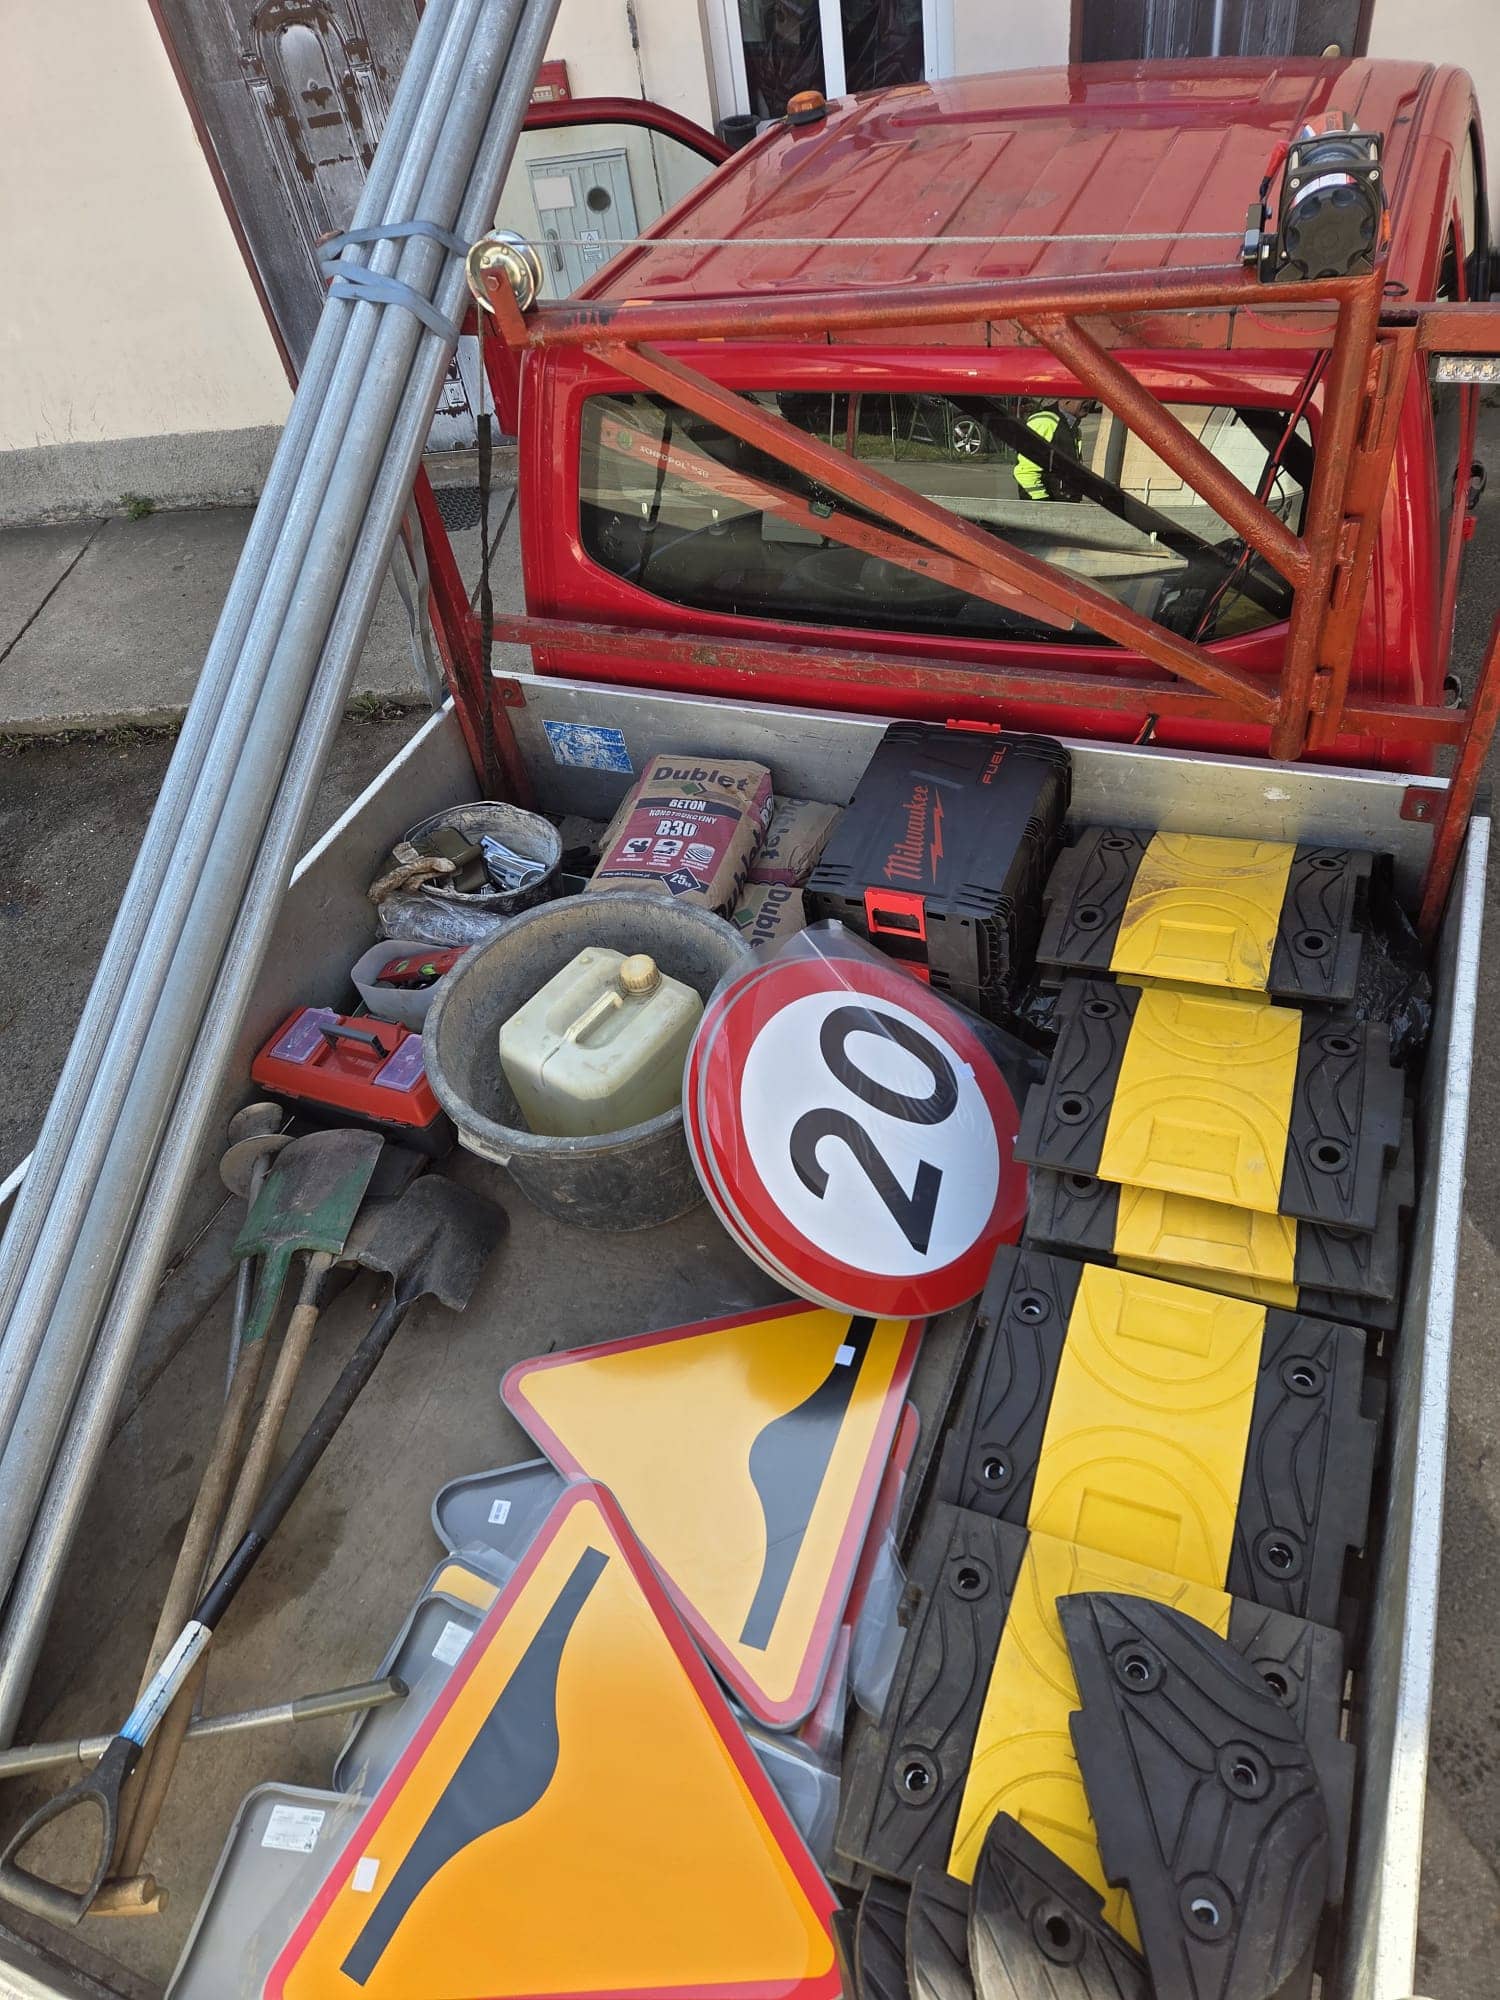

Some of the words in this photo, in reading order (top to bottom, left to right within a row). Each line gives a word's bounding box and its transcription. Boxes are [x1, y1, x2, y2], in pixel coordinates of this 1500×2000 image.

[652, 766, 749, 792] Dublet
[982, 746, 1007, 785] FUEL
[648, 809, 718, 825] KONSTRUKCYJNY
[669, 799, 707, 812] BETON
[655, 819, 698, 837] B30
[883, 785, 929, 881] Milwaukee
[750, 888, 793, 950] Duble
[789, 1005, 959, 1256] 20
